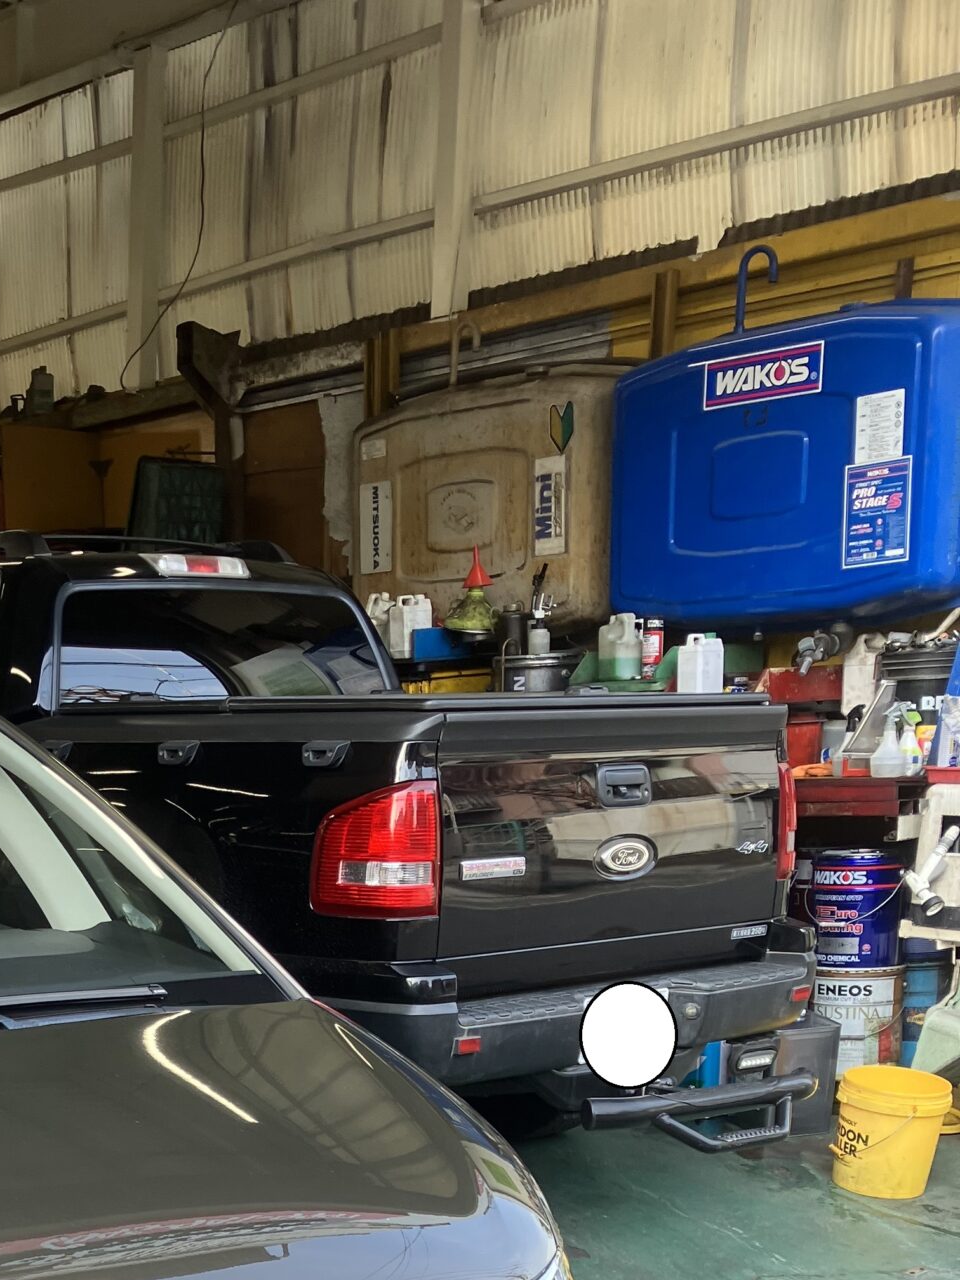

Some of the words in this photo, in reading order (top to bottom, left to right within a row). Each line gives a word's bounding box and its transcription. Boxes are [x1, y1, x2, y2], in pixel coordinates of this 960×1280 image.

[716, 356, 810, 396] WAKO'S
[852, 486, 876, 499] PRO
[535, 473, 552, 540] Mini
[853, 495, 889, 510] STAGE
[372, 486, 380, 570] MITSUOKA
[615, 849, 639, 865] Ford
[814, 871, 867, 885] WAKO'S
[815, 905, 859, 919] Euro
[817, 983, 873, 996] ENEOS
[817, 1005, 881, 1020] SUSTINA
